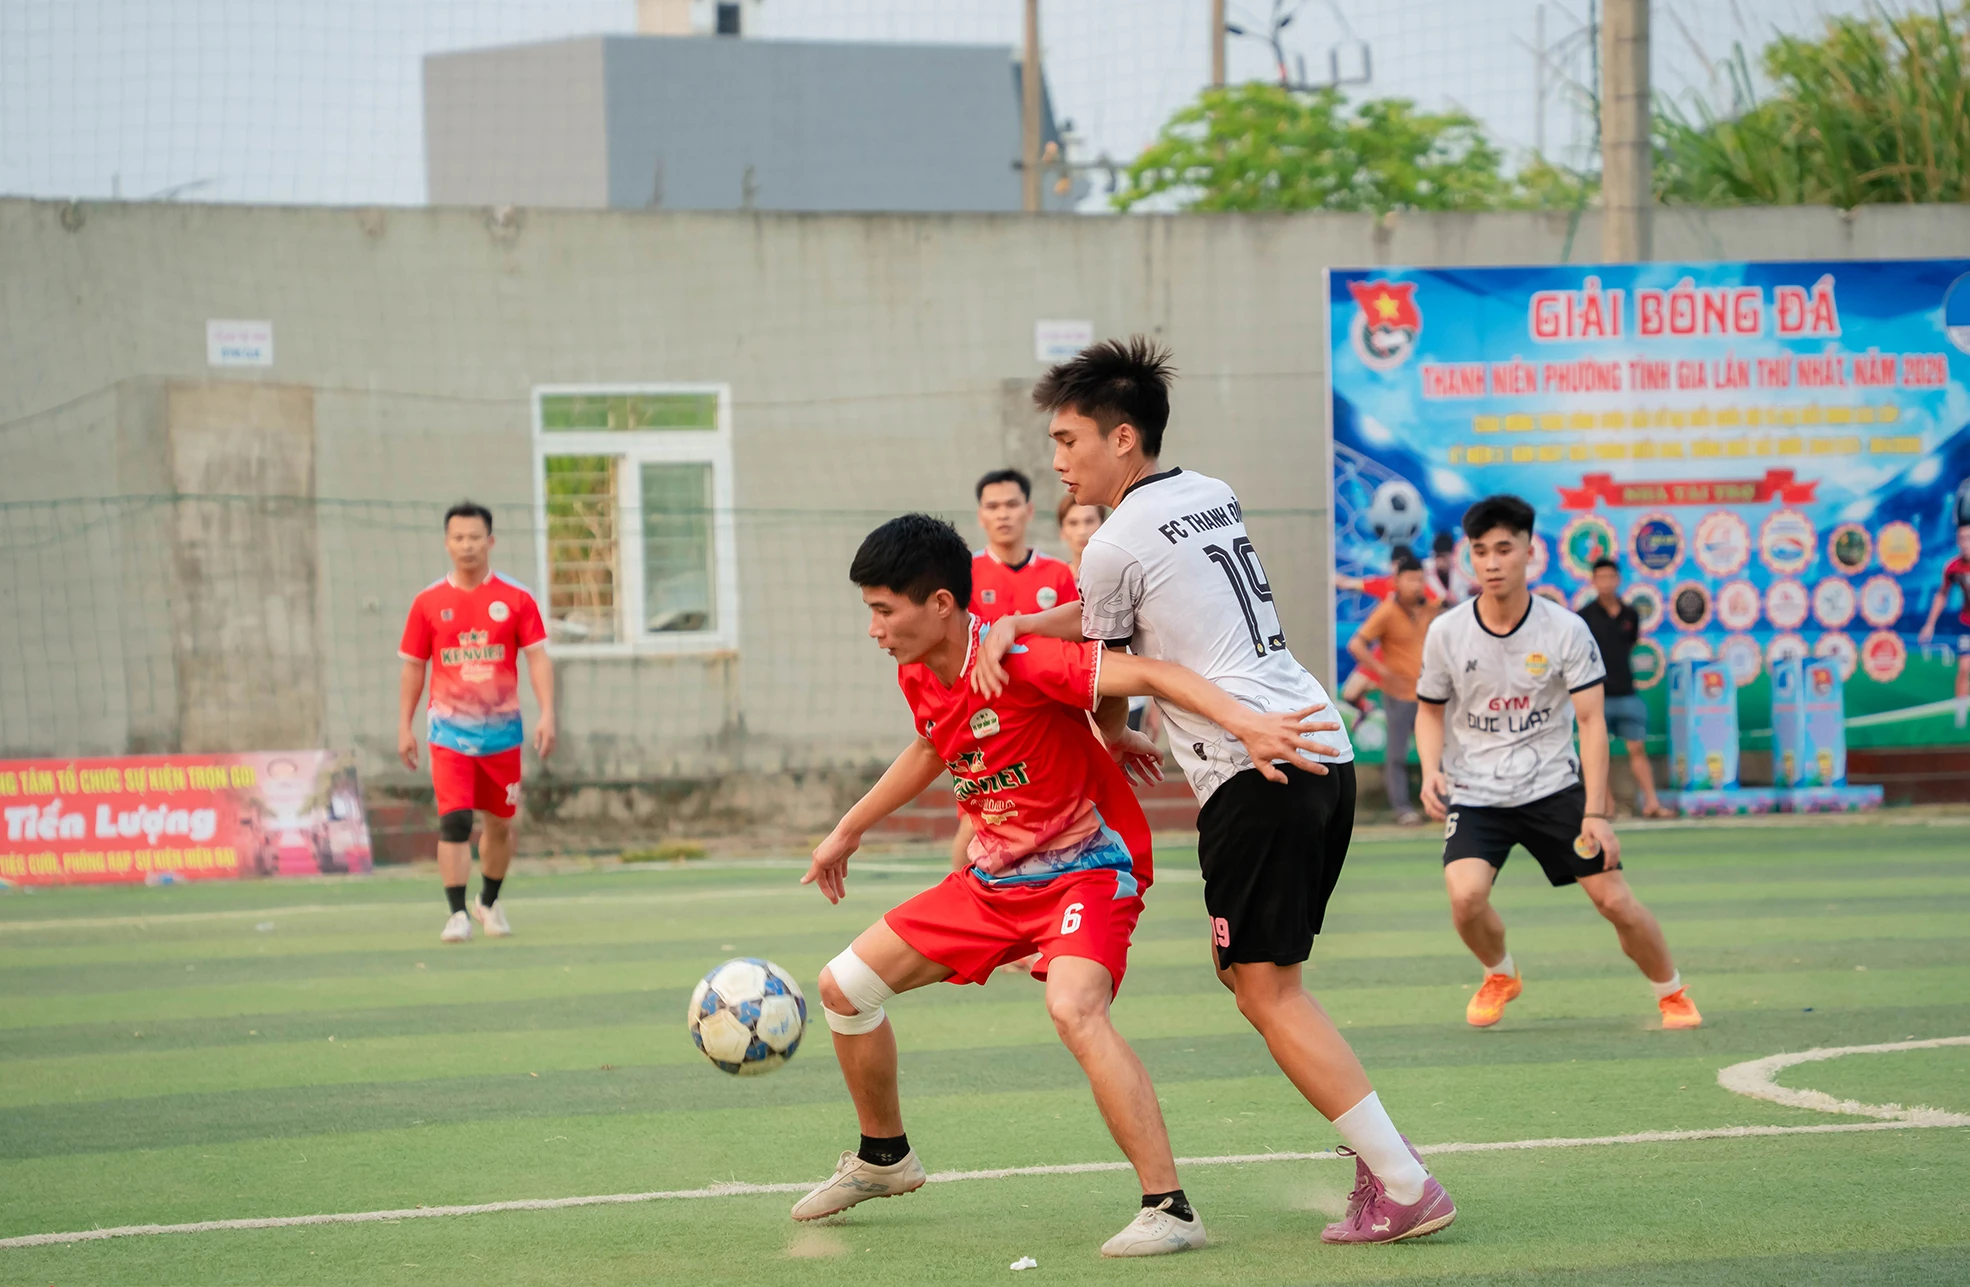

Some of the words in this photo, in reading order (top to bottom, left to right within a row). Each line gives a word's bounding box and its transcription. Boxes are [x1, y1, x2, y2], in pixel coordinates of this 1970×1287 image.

[1531, 276, 1624, 340] GIẢI
[1637, 277, 1762, 337] BÓNG
[1774, 274, 1841, 336] ĐÁ
[1423, 365, 1485, 396] THANH
[1676, 360, 1706, 390] GIA
[1158, 520, 1189, 545] FC
[1181, 506, 1233, 533] THANH
[1202, 536, 1286, 658] 19
[1489, 696, 1530, 711] GYM
[4, 798, 85, 841] Tiến
[95, 803, 217, 845] Lượng
[1445, 811, 1459, 840] 6
[1060, 902, 1084, 935] 6
